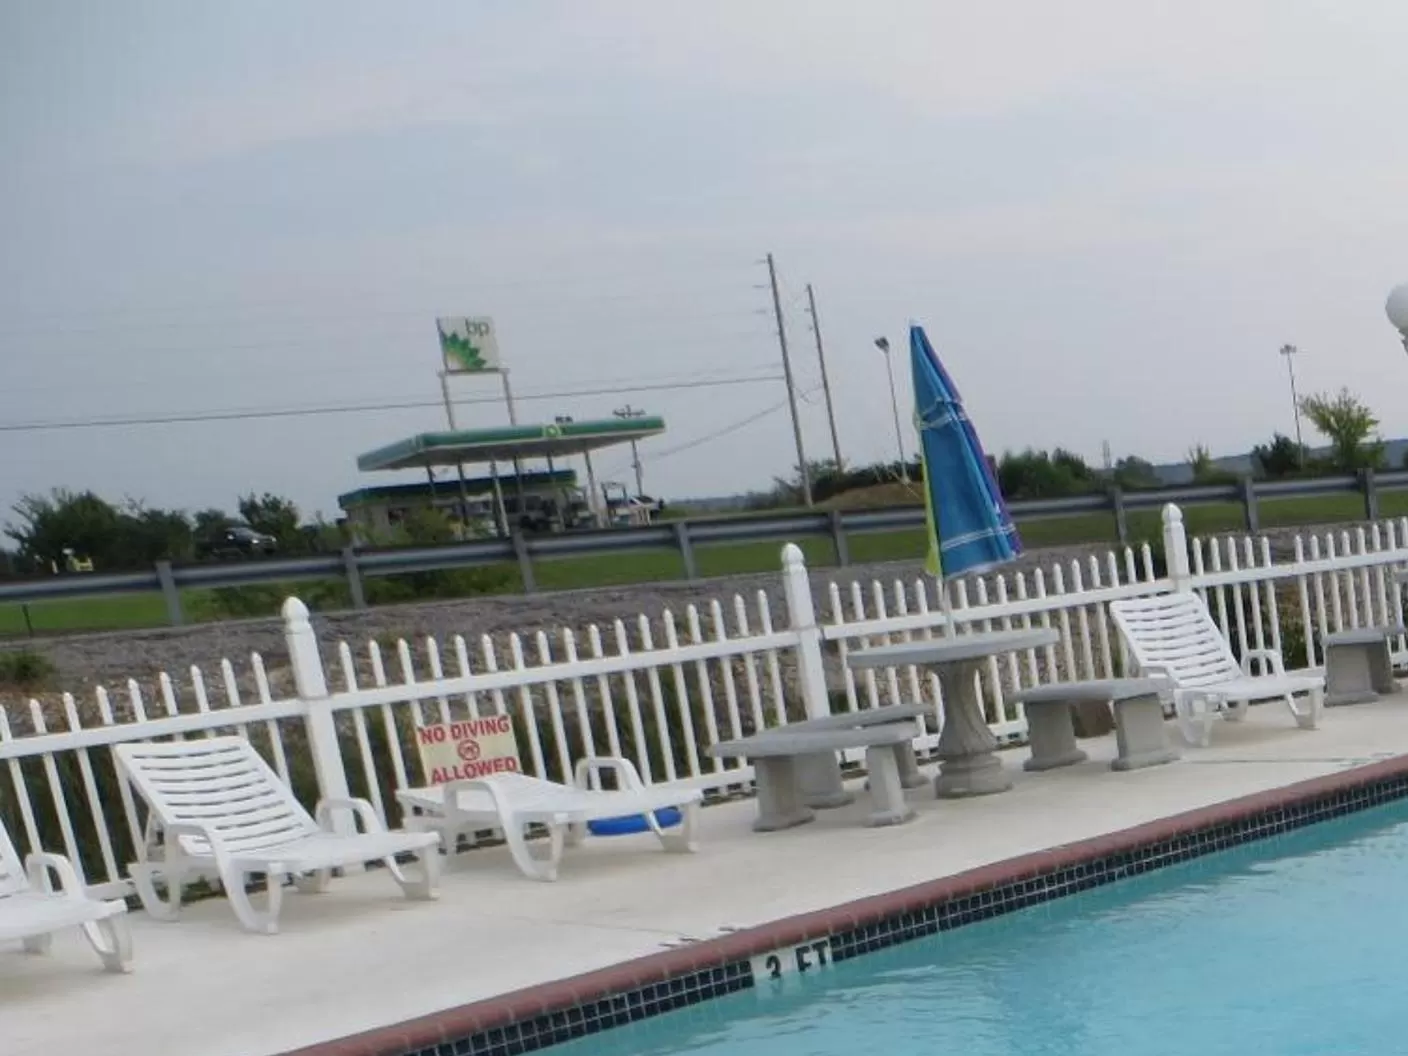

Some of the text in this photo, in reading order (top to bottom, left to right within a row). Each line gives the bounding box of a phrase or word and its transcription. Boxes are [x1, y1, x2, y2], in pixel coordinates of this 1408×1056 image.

[465, 317, 490, 337] bp
[419, 714, 510, 744] NO DIVING
[431, 756, 518, 784] ALLOWED
[796, 940, 828, 973] FT
